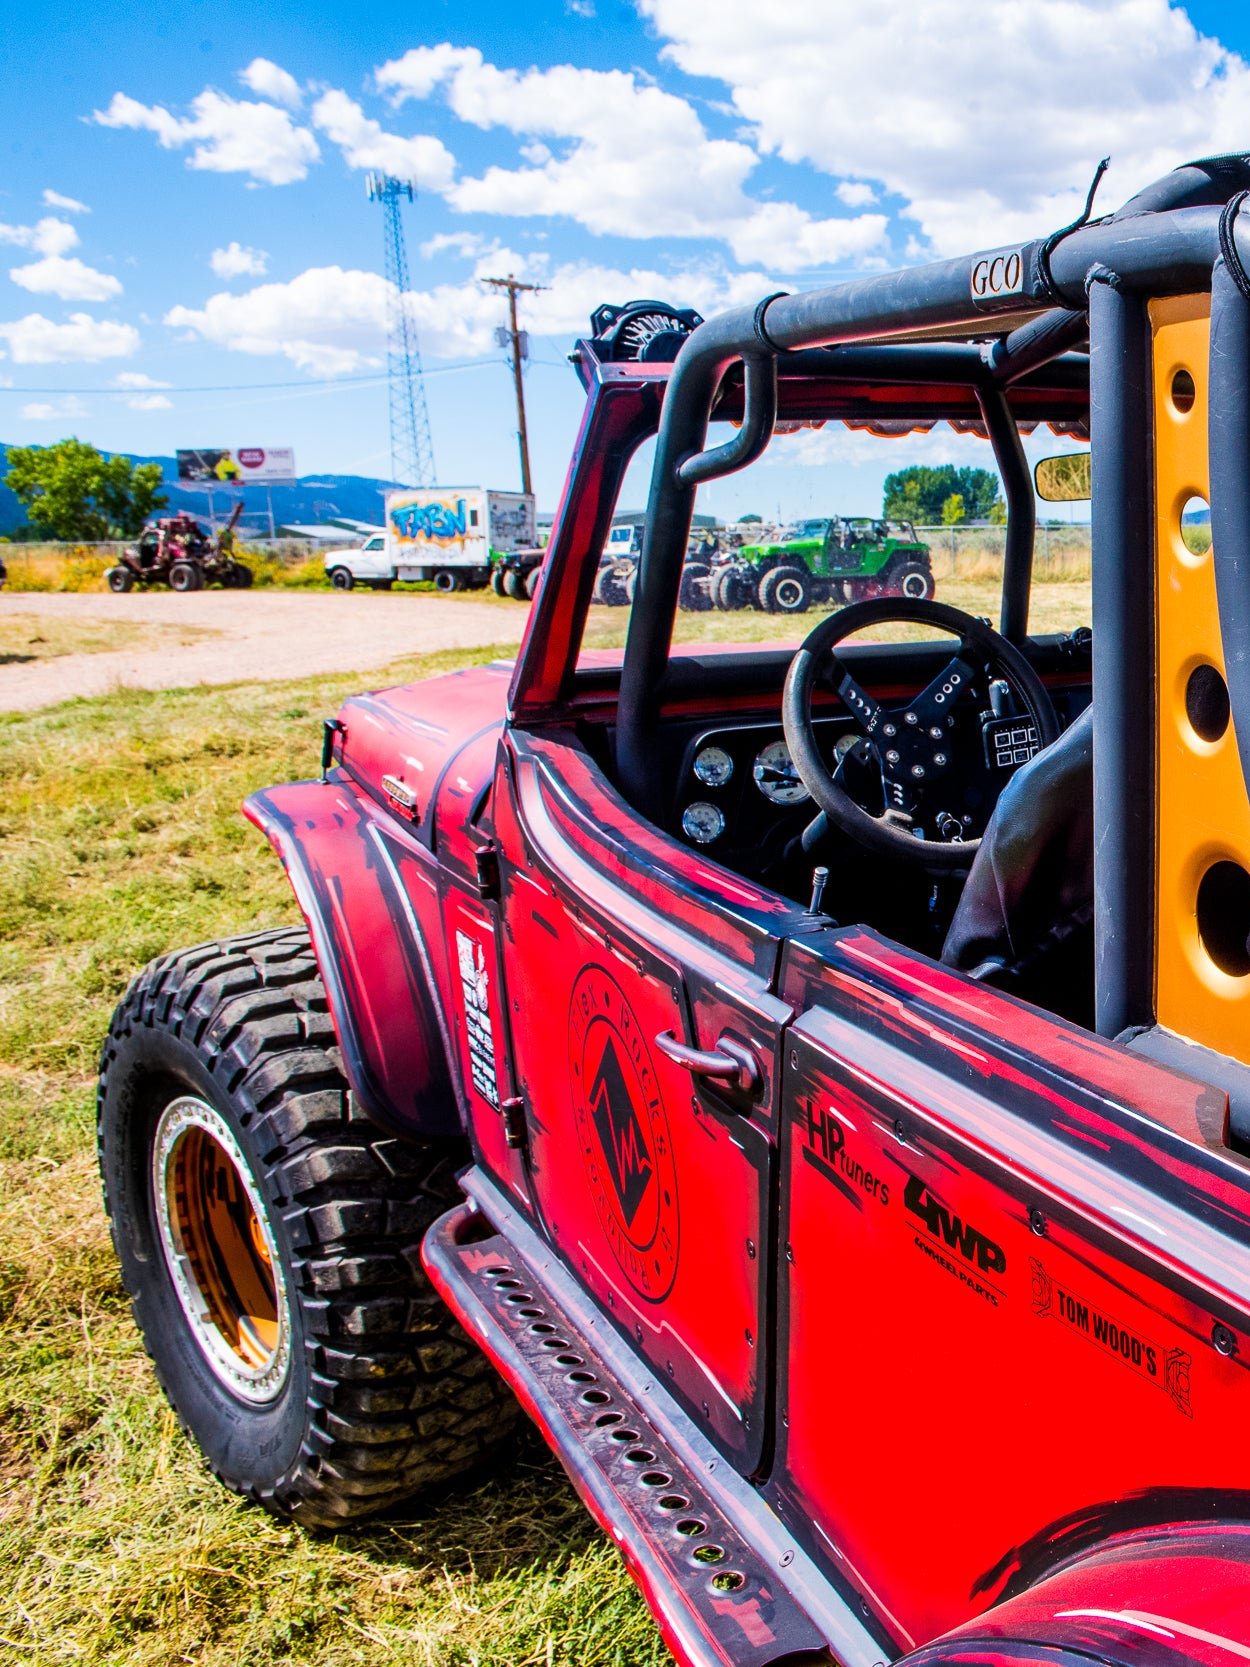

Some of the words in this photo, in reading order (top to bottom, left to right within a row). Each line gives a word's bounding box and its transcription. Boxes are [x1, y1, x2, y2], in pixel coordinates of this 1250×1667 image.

[972, 253, 1020, 296] GCO
[572, 983, 598, 1041] Flex
[619, 1002, 666, 1155] Rocks
[904, 1175, 1007, 1275] 4WP
[959, 1271, 998, 1307] PARTS
[1057, 1289, 1089, 1333] TOM
[1092, 1311, 1157, 1377] WOOD'S
